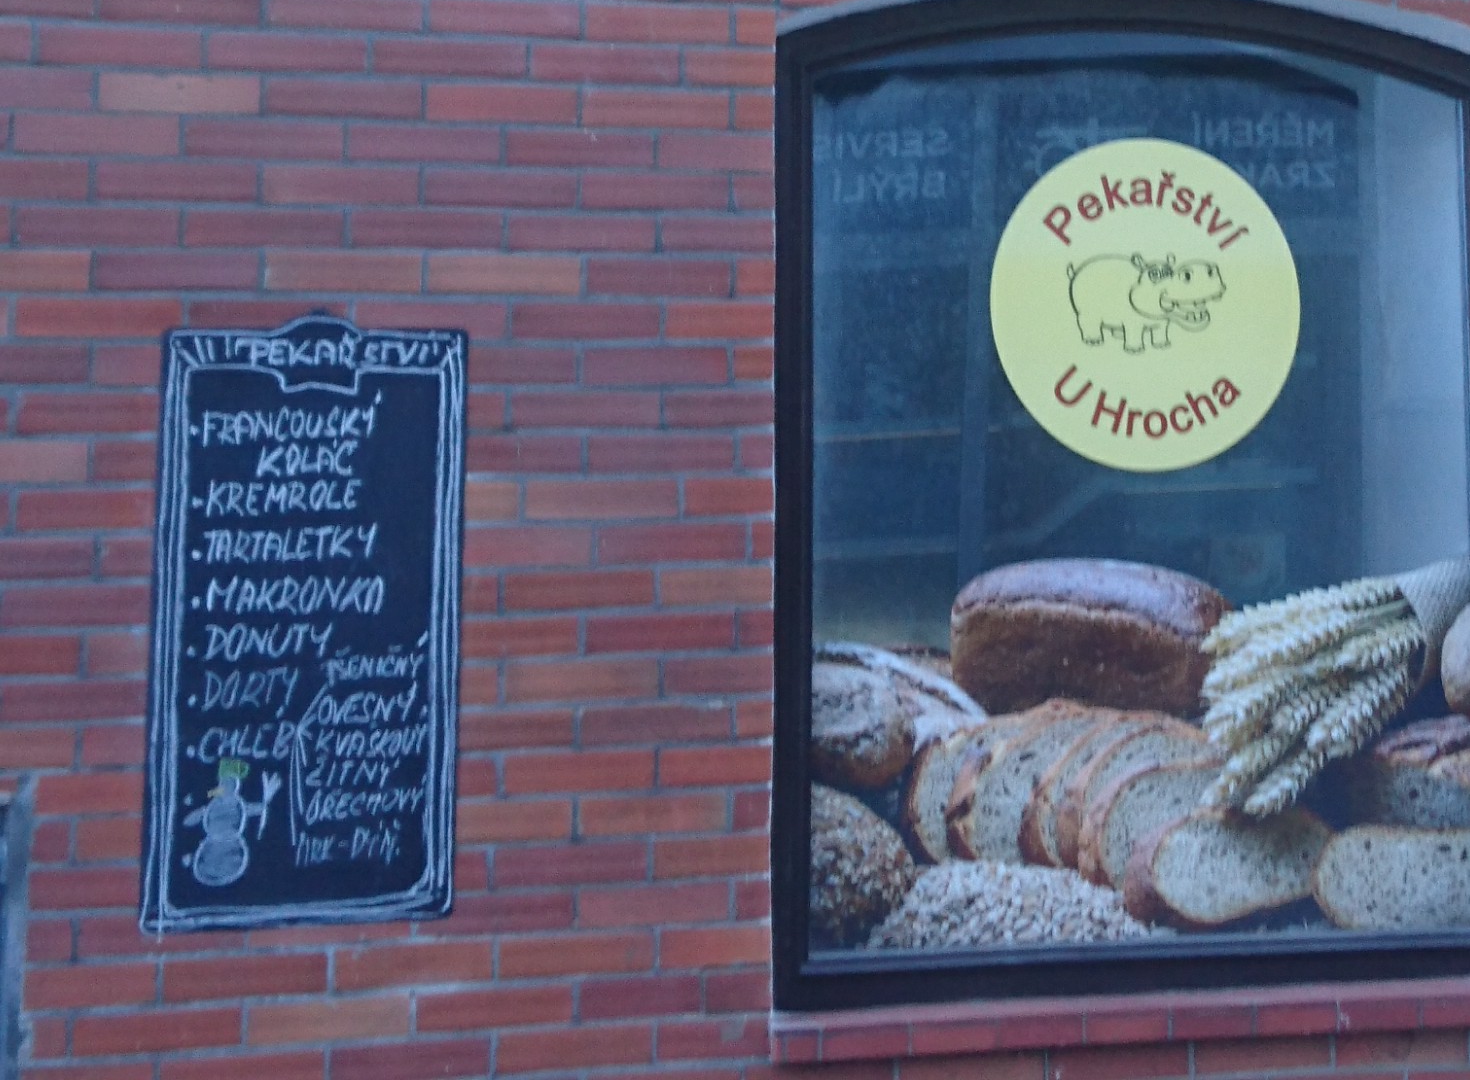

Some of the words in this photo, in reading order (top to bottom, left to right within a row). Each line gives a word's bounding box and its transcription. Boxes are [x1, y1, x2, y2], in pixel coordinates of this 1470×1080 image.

[1042, 171, 1250, 251] Pekařství
[1053, 364, 1094, 408] U
[1091, 373, 1241, 439] Hrocha
[205, 479, 362, 517] KREMROLE
[203, 522, 377, 565] TARTALETKY
[205, 622, 333, 661] DONUTY
[201, 667, 299, 712] DORTY
